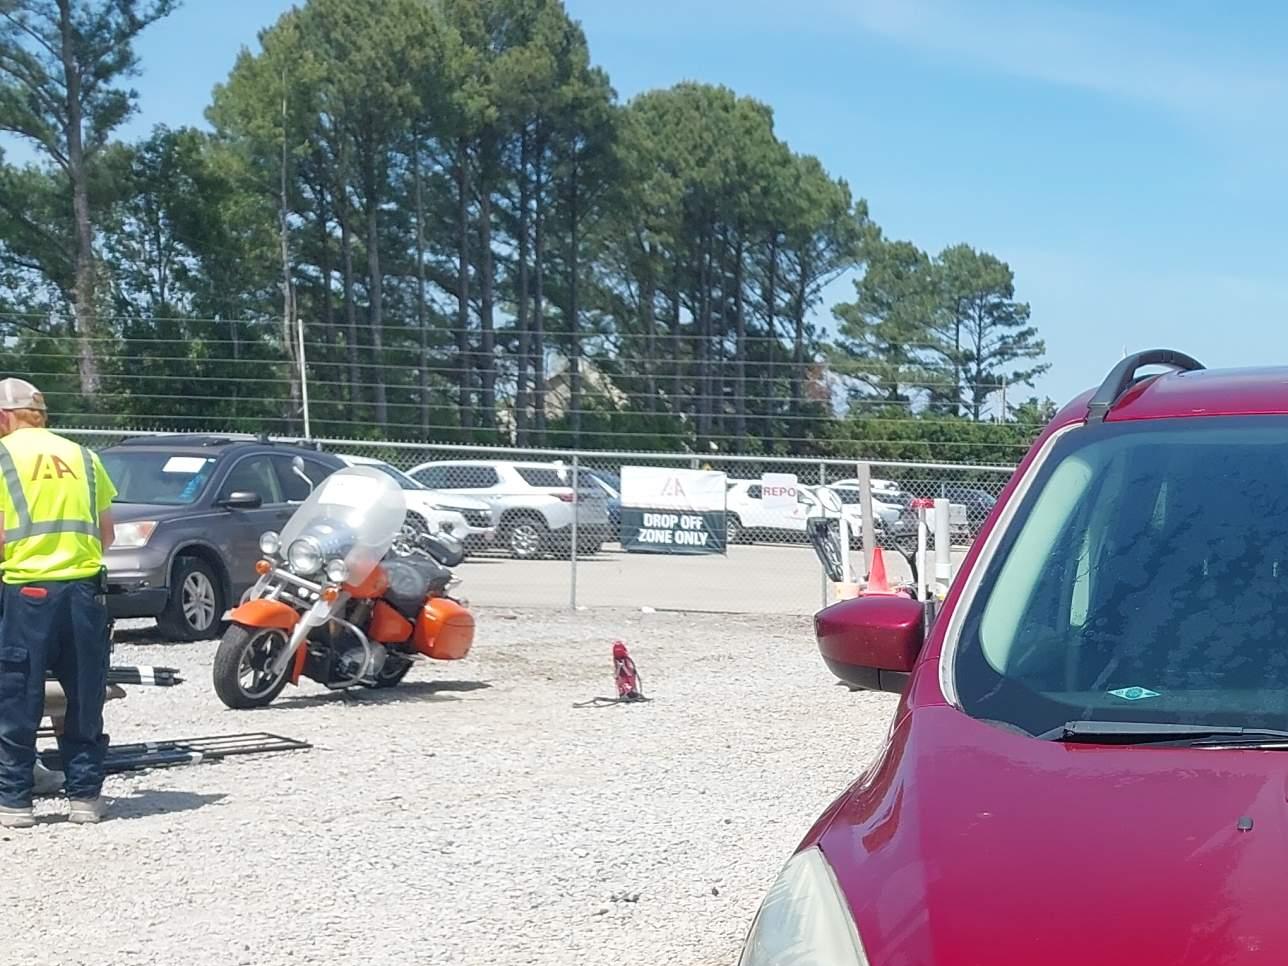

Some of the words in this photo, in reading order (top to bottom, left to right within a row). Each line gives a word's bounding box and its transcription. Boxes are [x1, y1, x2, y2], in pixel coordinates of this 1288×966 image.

[763, 486, 796, 497] REPO
[643, 512, 679, 529] DROP
[680, 514, 703, 530] OFF
[637, 528, 673, 544] ZONE
[674, 530, 709, 546] ONLY
